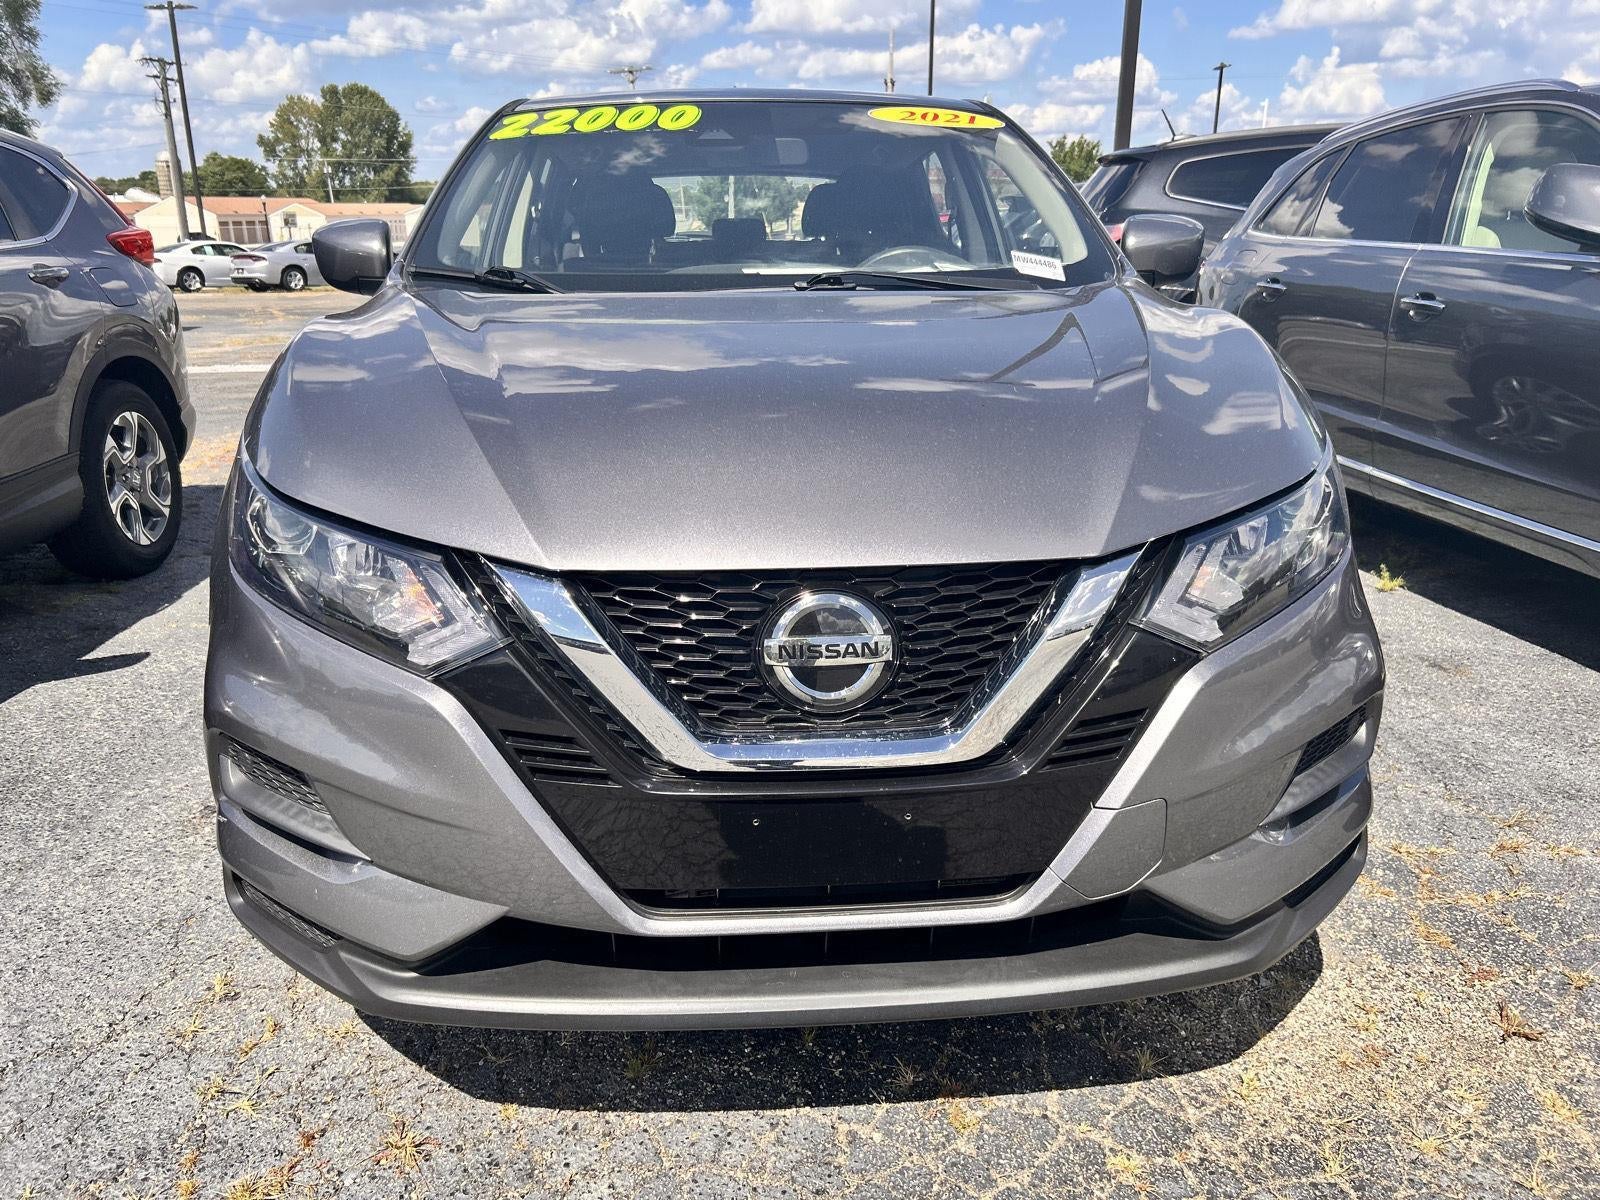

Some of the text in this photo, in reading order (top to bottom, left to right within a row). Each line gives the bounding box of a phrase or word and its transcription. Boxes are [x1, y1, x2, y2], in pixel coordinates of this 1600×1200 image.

[489, 104, 702, 140] 22000
[900, 110, 977, 125] 2021
[778, 641, 880, 660] NISSAN
